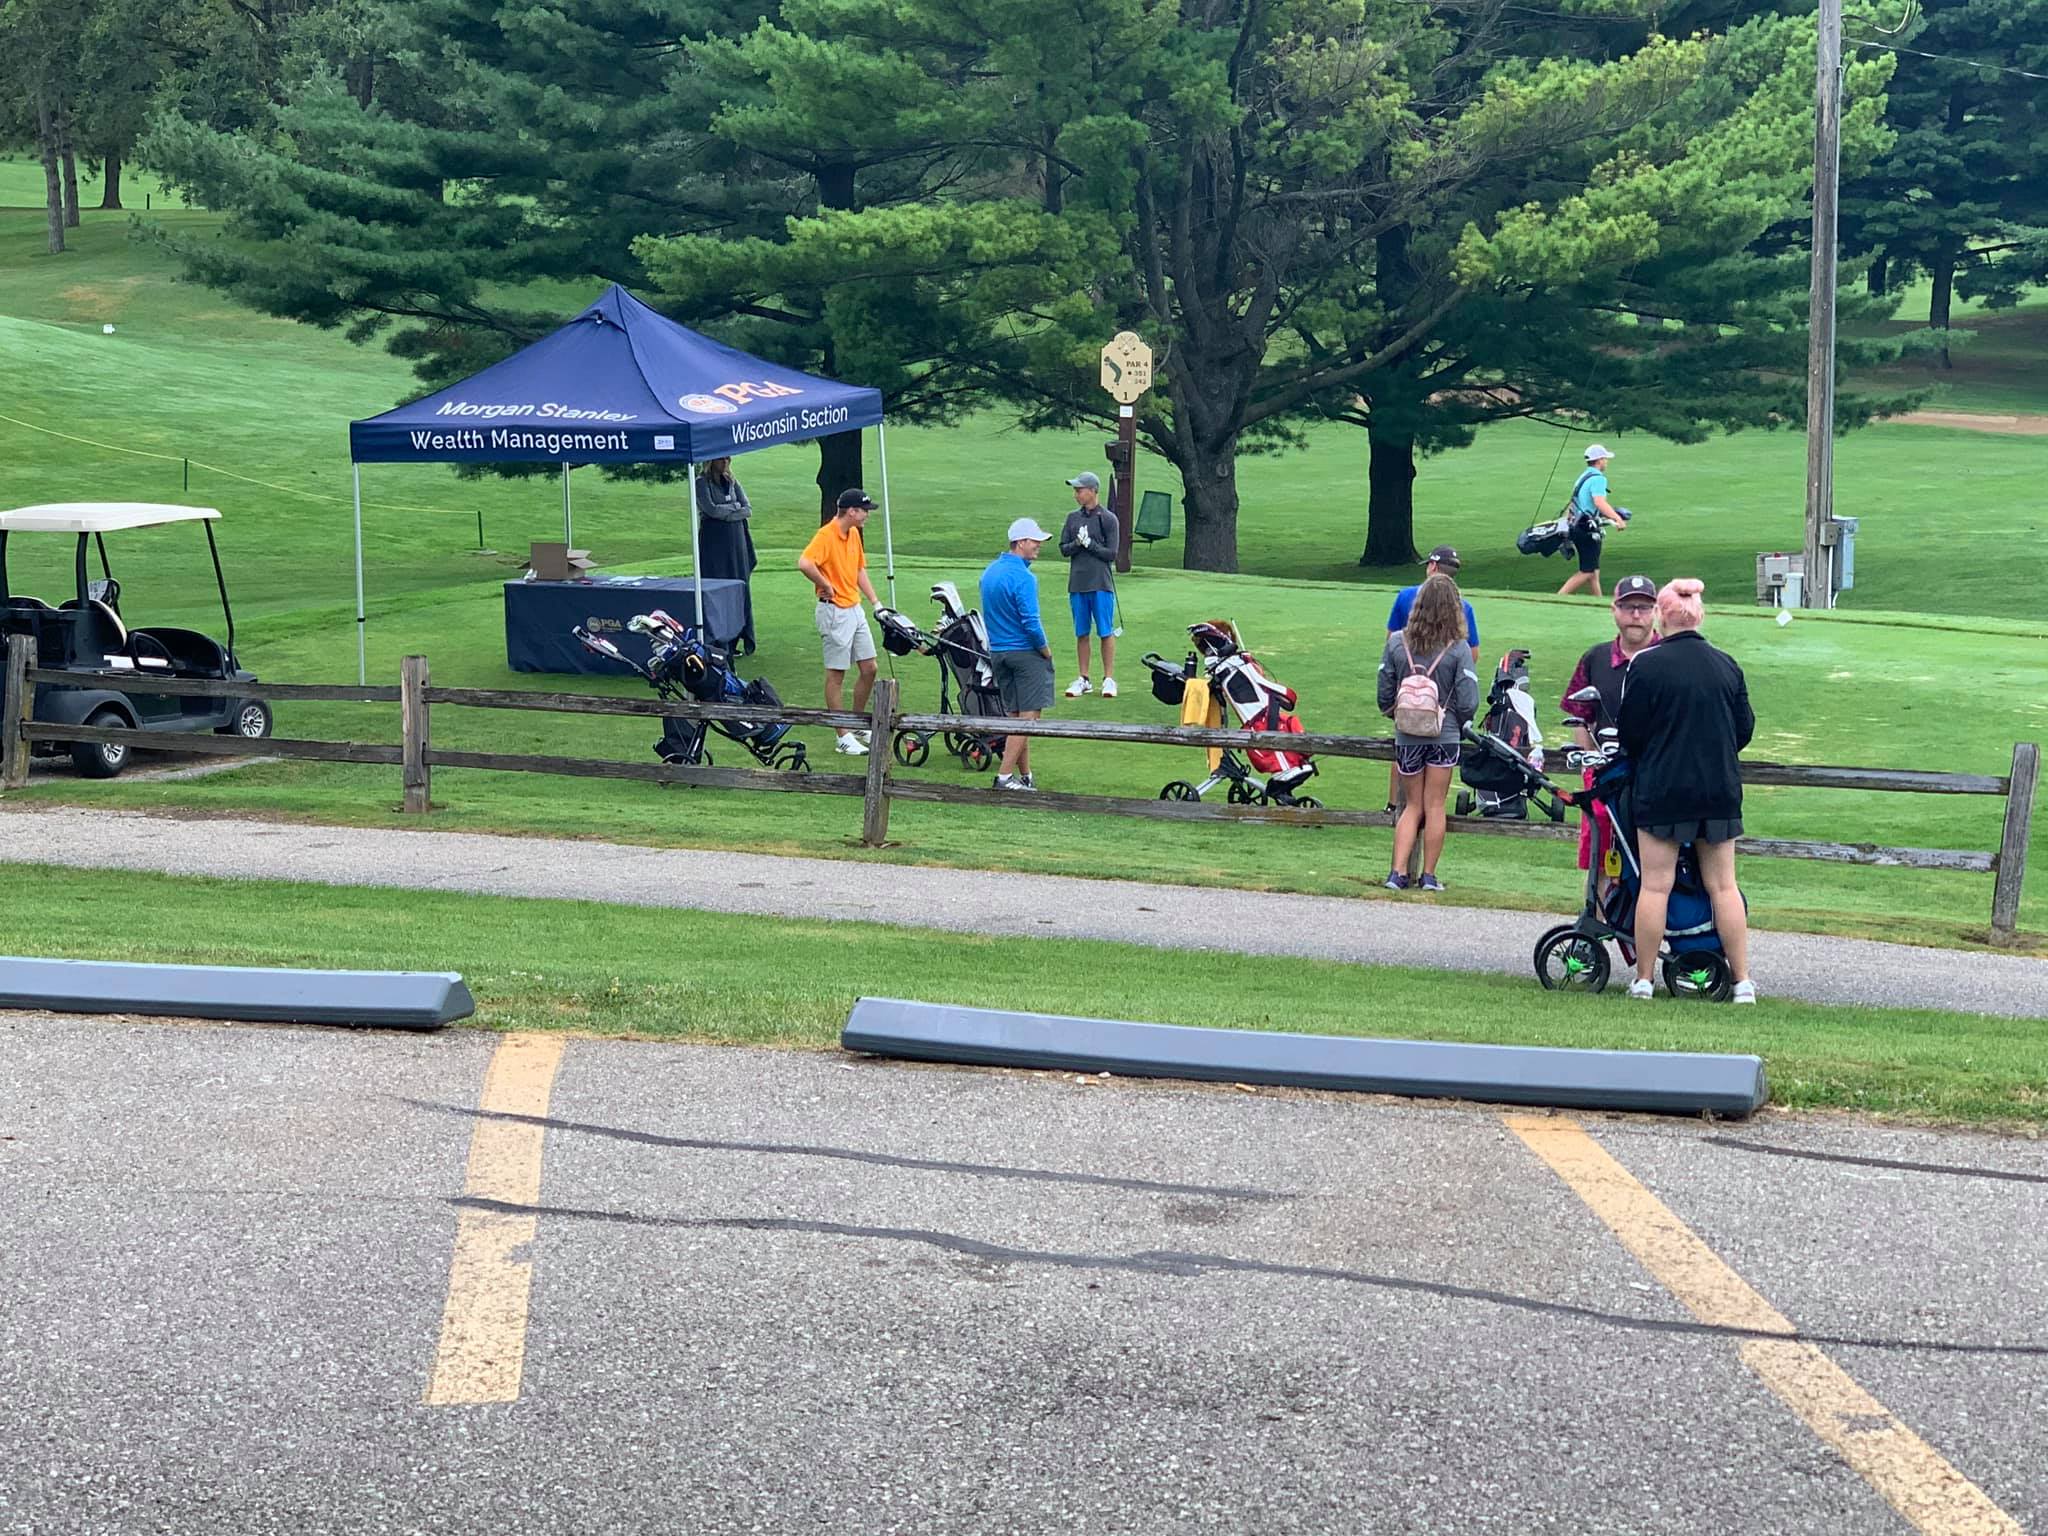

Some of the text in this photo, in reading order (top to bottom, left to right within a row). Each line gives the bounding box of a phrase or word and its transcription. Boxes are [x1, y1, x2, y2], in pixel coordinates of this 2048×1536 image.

[713, 380, 805, 405] PGA
[1123, 391, 1128, 400] 1
[435, 401, 638, 423] Morgan Stanley
[732, 404, 849, 444] Wisconsin Section
[410, 429, 485, 450] Wealth
[491, 429, 629, 454] Management
[600, 618, 621, 627] PGA
